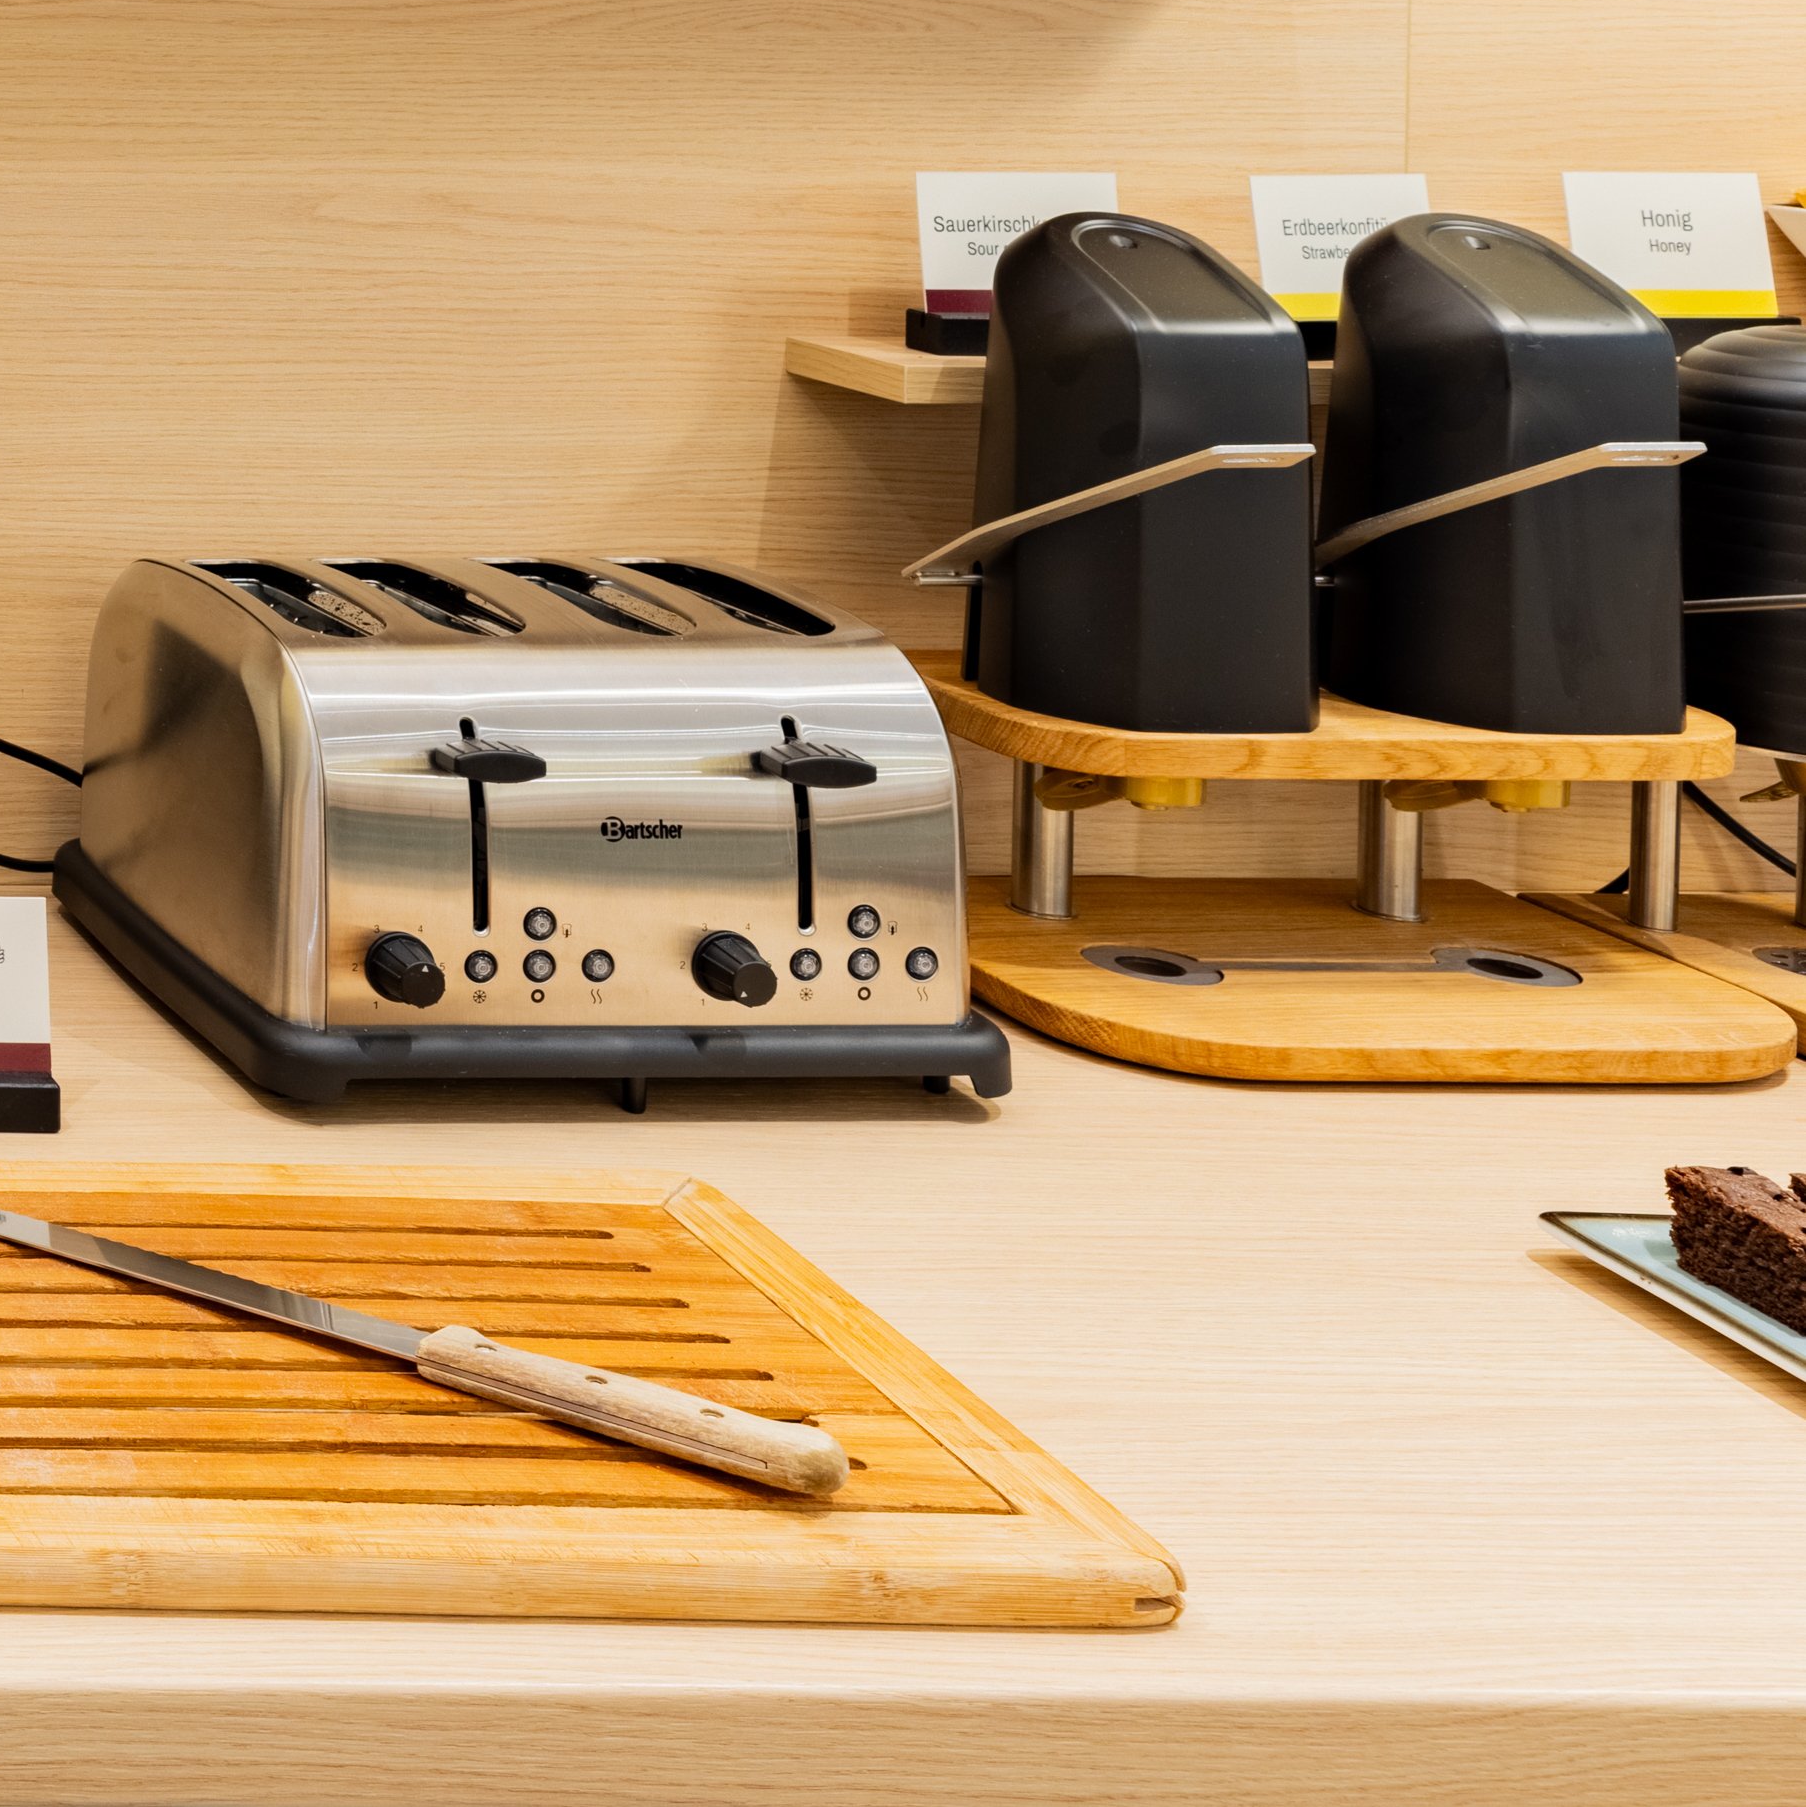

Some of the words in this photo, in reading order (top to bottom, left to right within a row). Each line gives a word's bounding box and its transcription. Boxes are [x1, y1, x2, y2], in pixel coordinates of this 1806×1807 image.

[933, 215, 1045, 233] Sauerkirschk
[1641, 210, 1694, 231] Honig
[968, 242, 999, 256] Sour
[1301, 245, 1354, 260] Strawbe
[1649, 239, 1692, 256] Honey
[601, 816, 683, 842] Bartscher
[373, 924, 380, 934] 3
[417, 924, 424, 933] 4
[701, 922, 708, 932] 3
[744, 922, 751, 931] 4
[351, 962, 358, 972] 2
[679, 960, 686, 970] 2
[373, 1001, 378, 1009] 1
